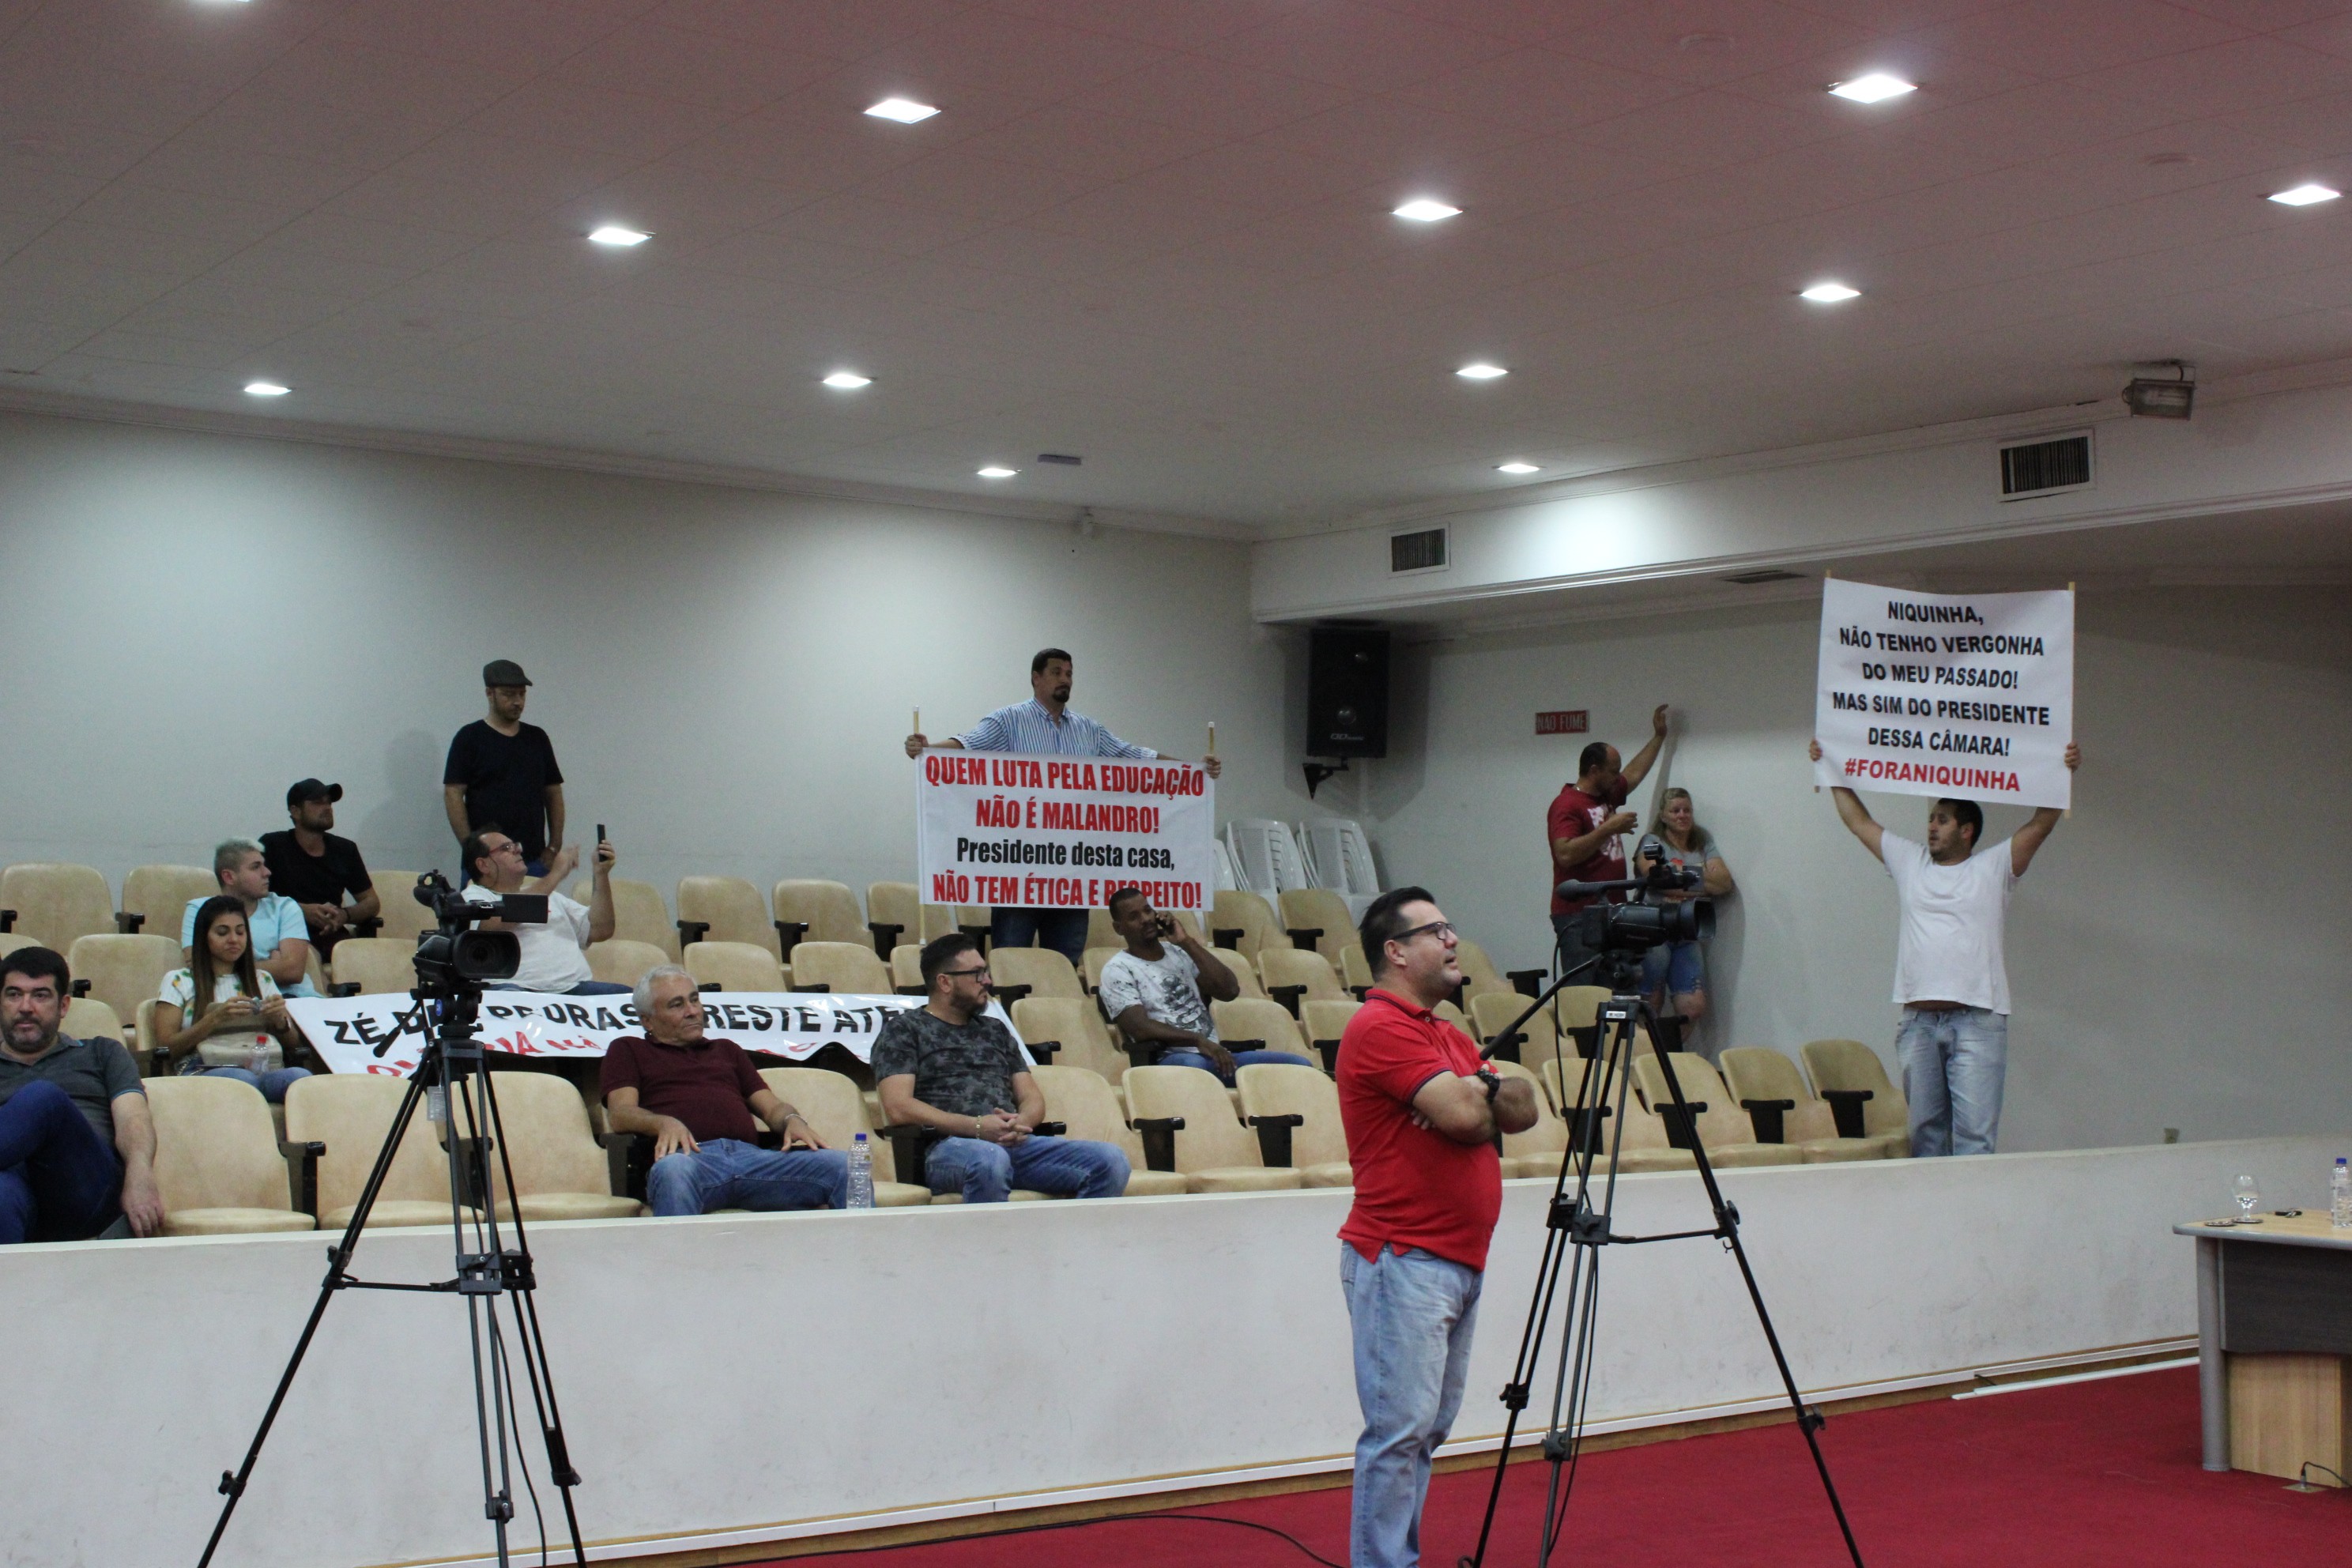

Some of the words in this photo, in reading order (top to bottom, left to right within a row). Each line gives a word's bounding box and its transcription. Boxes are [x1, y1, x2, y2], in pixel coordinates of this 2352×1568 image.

[1888, 601, 1984, 626] NIQUINHA,
[1840, 626, 1871, 648] NÃO
[1876, 633, 1936, 653] TENHO
[1941, 635, 2044, 656] VERGONHA
[1862, 662, 1886, 680] DO
[1891, 665, 1930, 684] MEU
[1935, 667, 2018, 689] PASSADO!
[1559, 713, 1585, 730] FUME
[1833, 692, 1868, 711] MAS
[1873, 695, 1903, 714] SIM
[1909, 698, 1932, 716] DO
[1938, 700, 2050, 726] PRESIDENTE
[1869, 727, 1924, 750] DESSA
[1930, 729, 2010, 756] CÂMARA!
[926, 755, 986, 786] QUEM
[993, 760, 1042, 787] LUTA
[1048, 762, 1096, 791] PELA
[1102, 764, 1204, 801] EDUCAÇÃO
[1845, 757, 2020, 791] #FORANIQUINHA
[976, 795, 1020, 828] NÃO
[1026, 797, 1037, 828] É
[1043, 802, 1159, 834] MALANDRO!
[957, 838, 1066, 865] Presidente
[1072, 841, 1123, 867] desta
[1128, 847, 1174, 871] casa,
[933, 869, 969, 903] NÃO
[975, 876, 1018, 904] TEM
[1024, 872, 1083, 906] ÉTICA
[1089, 880, 1099, 906] E
[324, 1012, 387, 1045] ZÉ
[703, 1004, 821, 1032] RESTE
